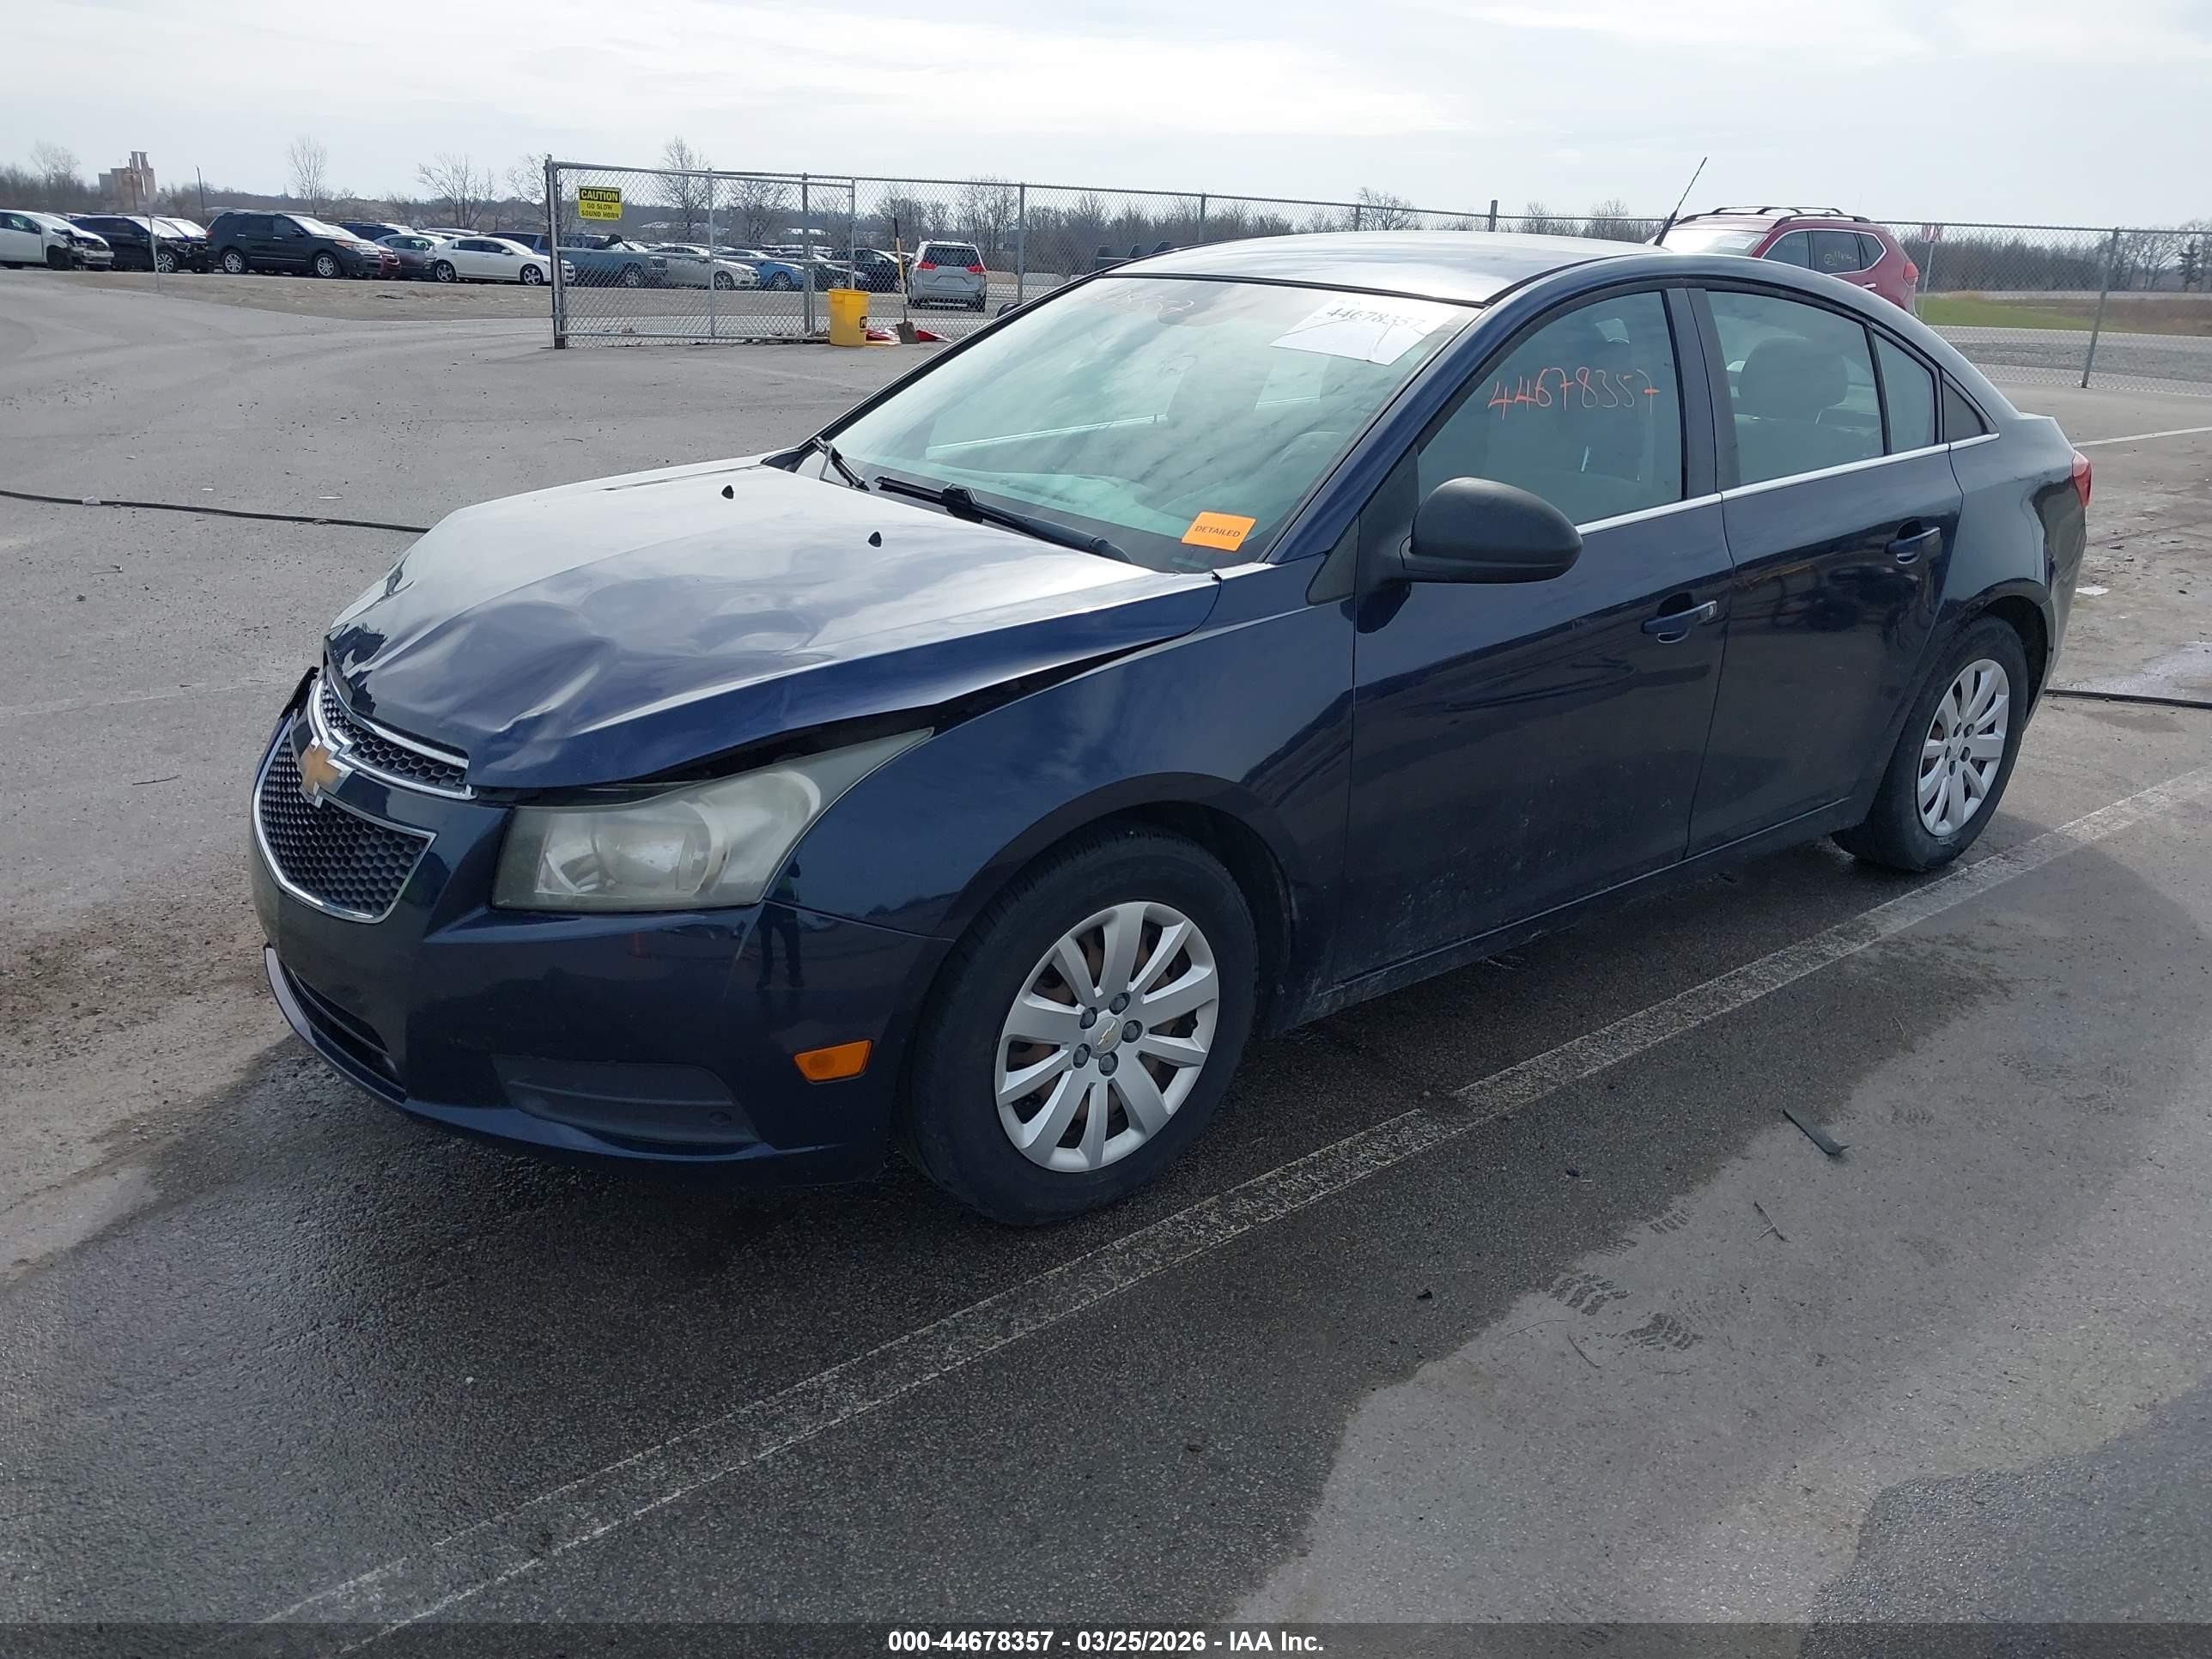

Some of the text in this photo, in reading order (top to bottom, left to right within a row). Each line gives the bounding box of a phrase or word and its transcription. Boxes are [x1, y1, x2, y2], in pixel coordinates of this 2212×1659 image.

[580, 190, 618, 201] CAUTION
[1487, 367, 1661, 420] 44678357
[1194, 526, 1241, 538] DETAILED
